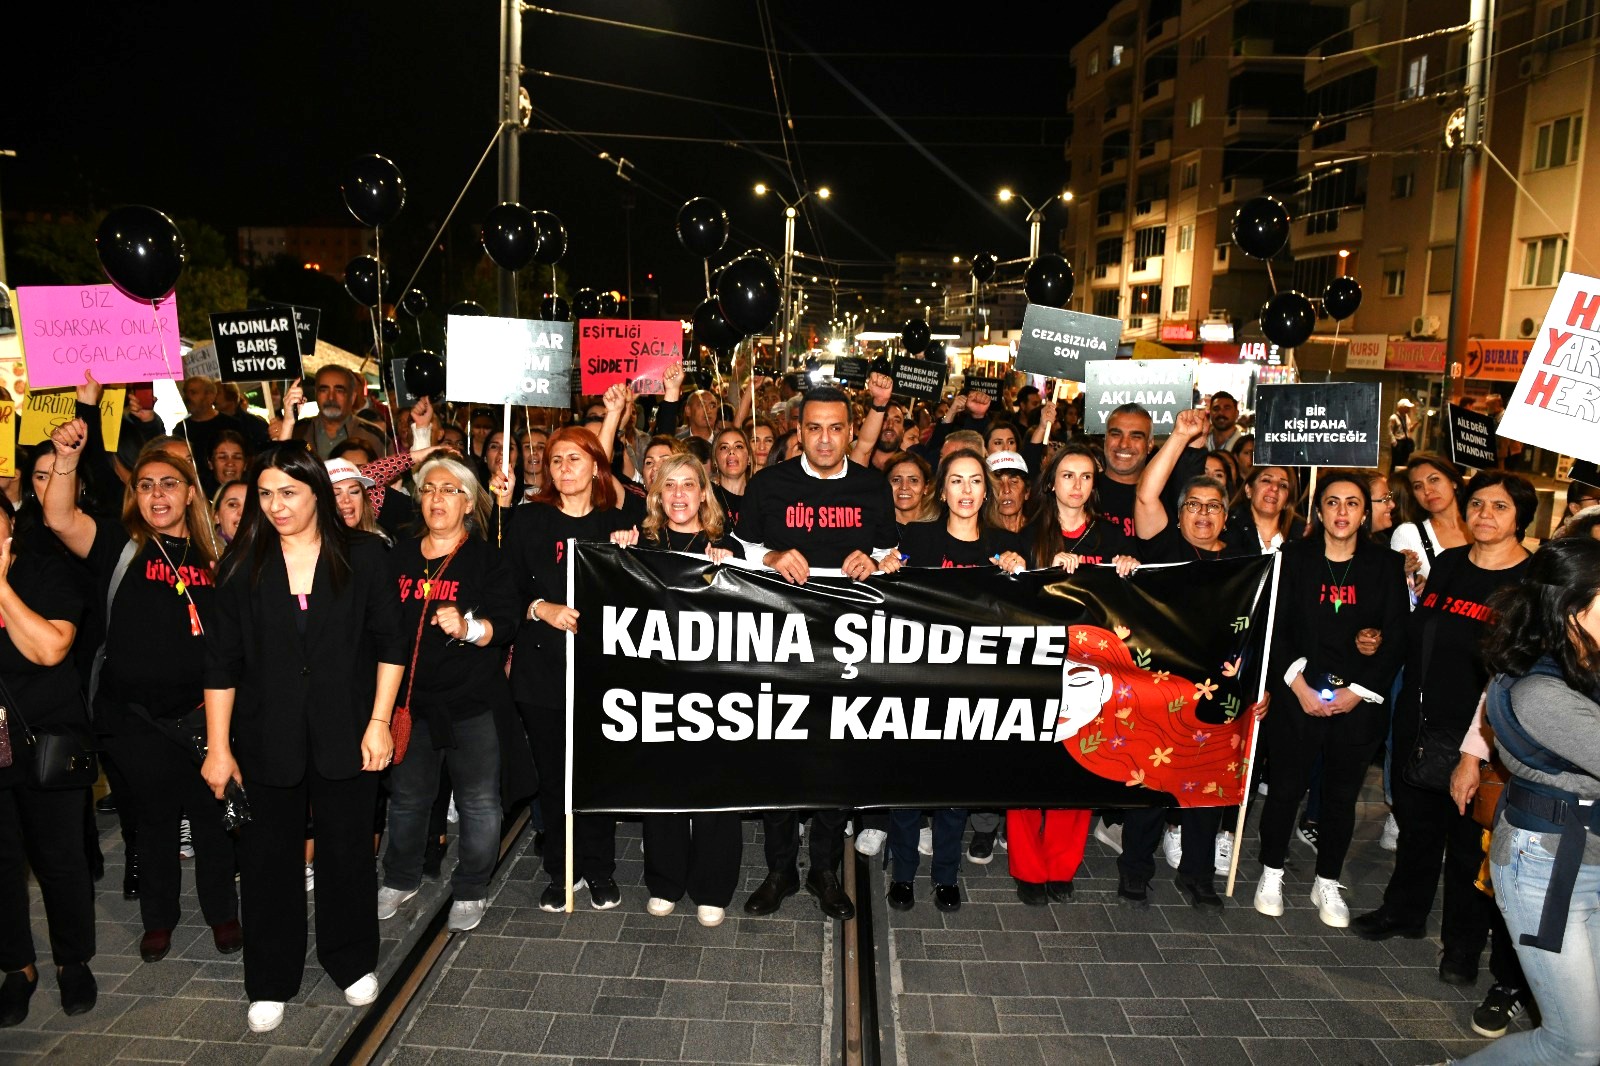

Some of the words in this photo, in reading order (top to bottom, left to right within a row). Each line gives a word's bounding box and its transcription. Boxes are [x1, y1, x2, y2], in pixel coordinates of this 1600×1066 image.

[80, 288, 114, 309] BİZ
[1566, 291, 1600, 332] H
[33, 319, 113, 338] SUSARSAK
[120, 317, 174, 336] ONLAR
[218, 318, 289, 336] KADINLAR
[582, 323, 641, 340] EŞİTLİĞİ
[236, 338, 278, 355] BARIŞ
[629, 337, 680, 356] SAĞLA
[1031, 328, 1107, 351] CEZASIZLIĞA
[52, 343, 165, 365] ÇOĞALACAK!
[1053, 346, 1080, 360] SON
[1240, 342, 1267, 360] ALFA
[1350, 342, 1380, 357] KURSU
[1484, 349, 1519, 365] BURAK
[231, 355, 287, 373] İSTİYOR
[587, 355, 638, 376] ŞİDDETİ
[899, 364, 913, 373] SEN
[913, 366, 927, 376] BEN
[927, 369, 939, 378] BİZ
[896, 371, 939, 386] BİRBİRİMİZİN
[898, 380, 933, 393] ÇARESİYİZ
[1099, 390, 1177, 405] AKLAMA
[1305, 404, 1326, 417] BİR
[1284, 418, 1308, 432] KİŞİ
[1310, 419, 1347, 429] DAHA
[1457, 416, 1470, 430] AİLE
[1470, 421, 1489, 436] DEĞİL
[1264, 430, 1367, 443] EKSİLMEYECEĞİZ
[1460, 430, 1487, 447] KADINIZ
[1456, 440, 1495, 462] İSYANDAYIZ
[785, 502, 814, 532] GÜÇ
[818, 506, 863, 528] SENDE
[602, 605, 815, 663] KADINA
[832, 609, 1067, 680] ŞİDDETE
[601, 682, 811, 743] SESSİZ
[829, 695, 1061, 742] KALMA!
